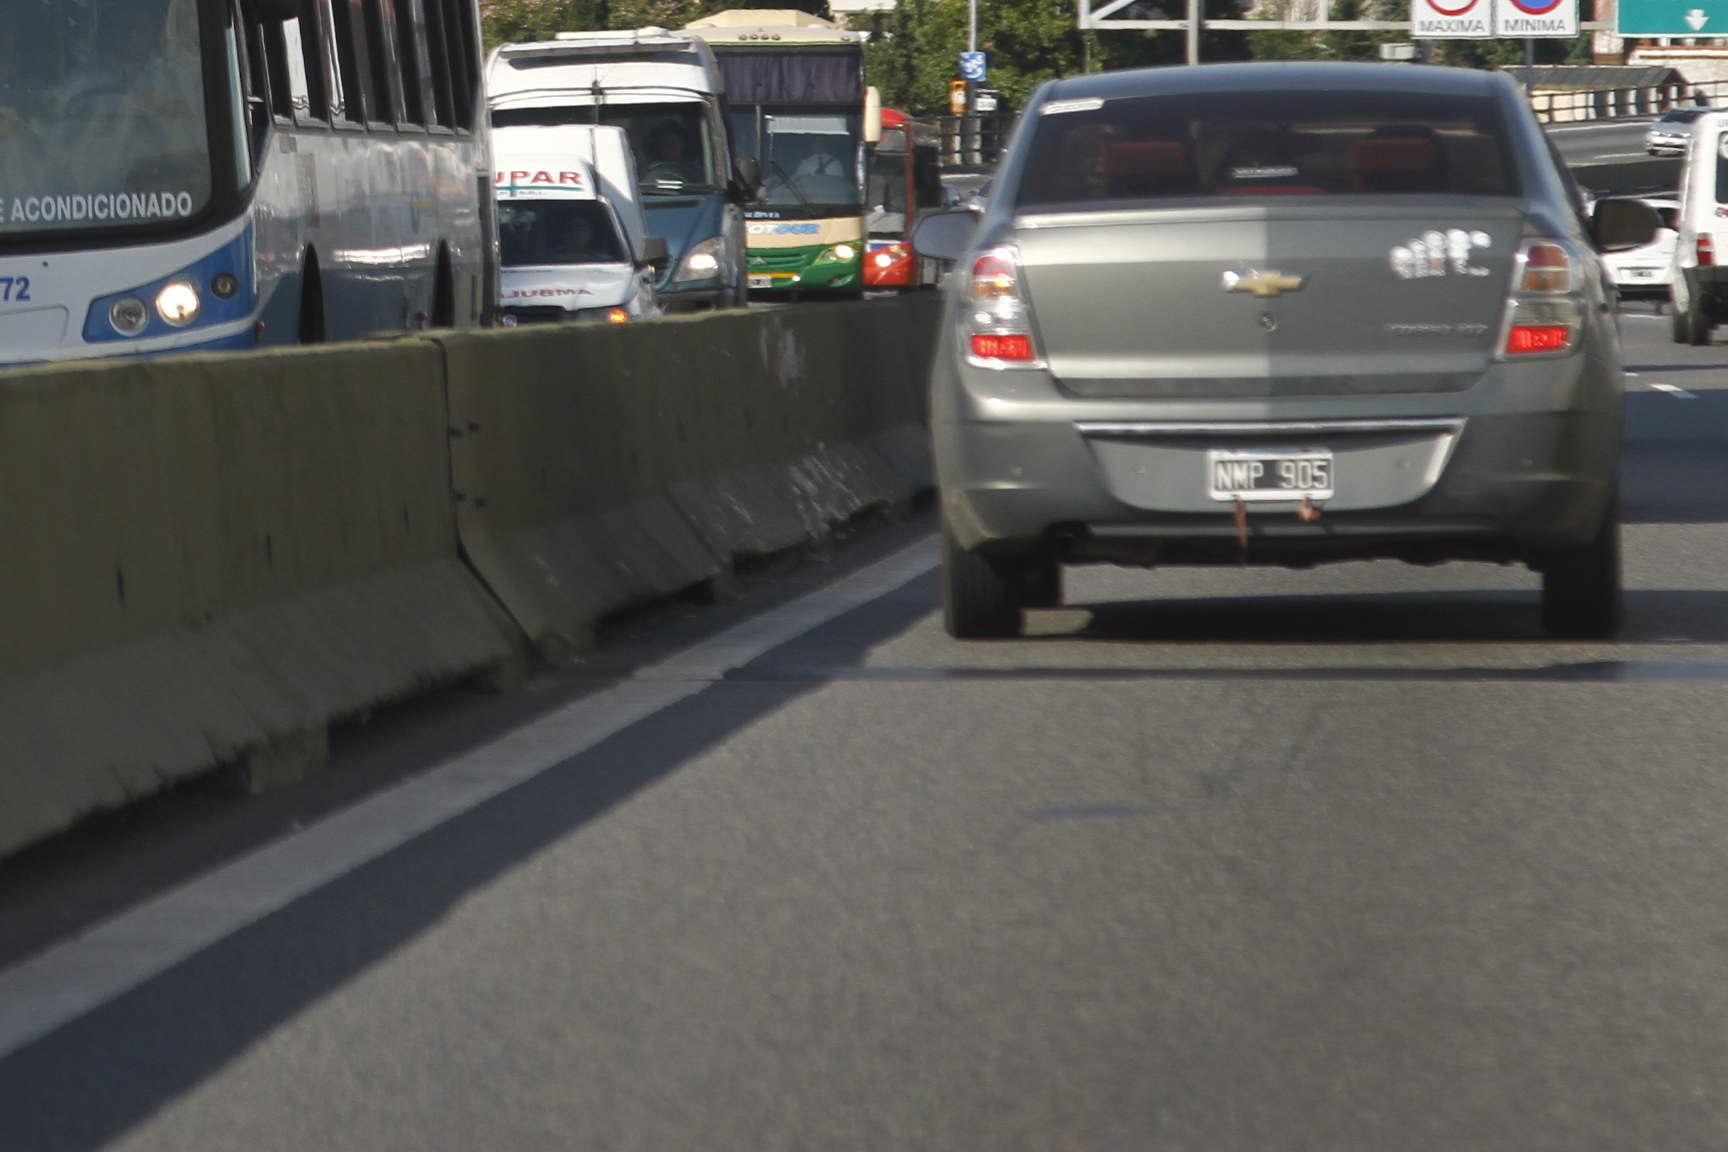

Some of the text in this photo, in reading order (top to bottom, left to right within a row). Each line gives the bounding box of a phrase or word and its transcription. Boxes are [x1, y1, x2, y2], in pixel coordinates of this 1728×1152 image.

[1419, 19, 1486, 34] MAXIMA
[1504, 18, 1567, 33] MINIMA
[11, 191, 193, 222] ACONDICIONADO
[1216, 460, 1329, 489] NMP 905
